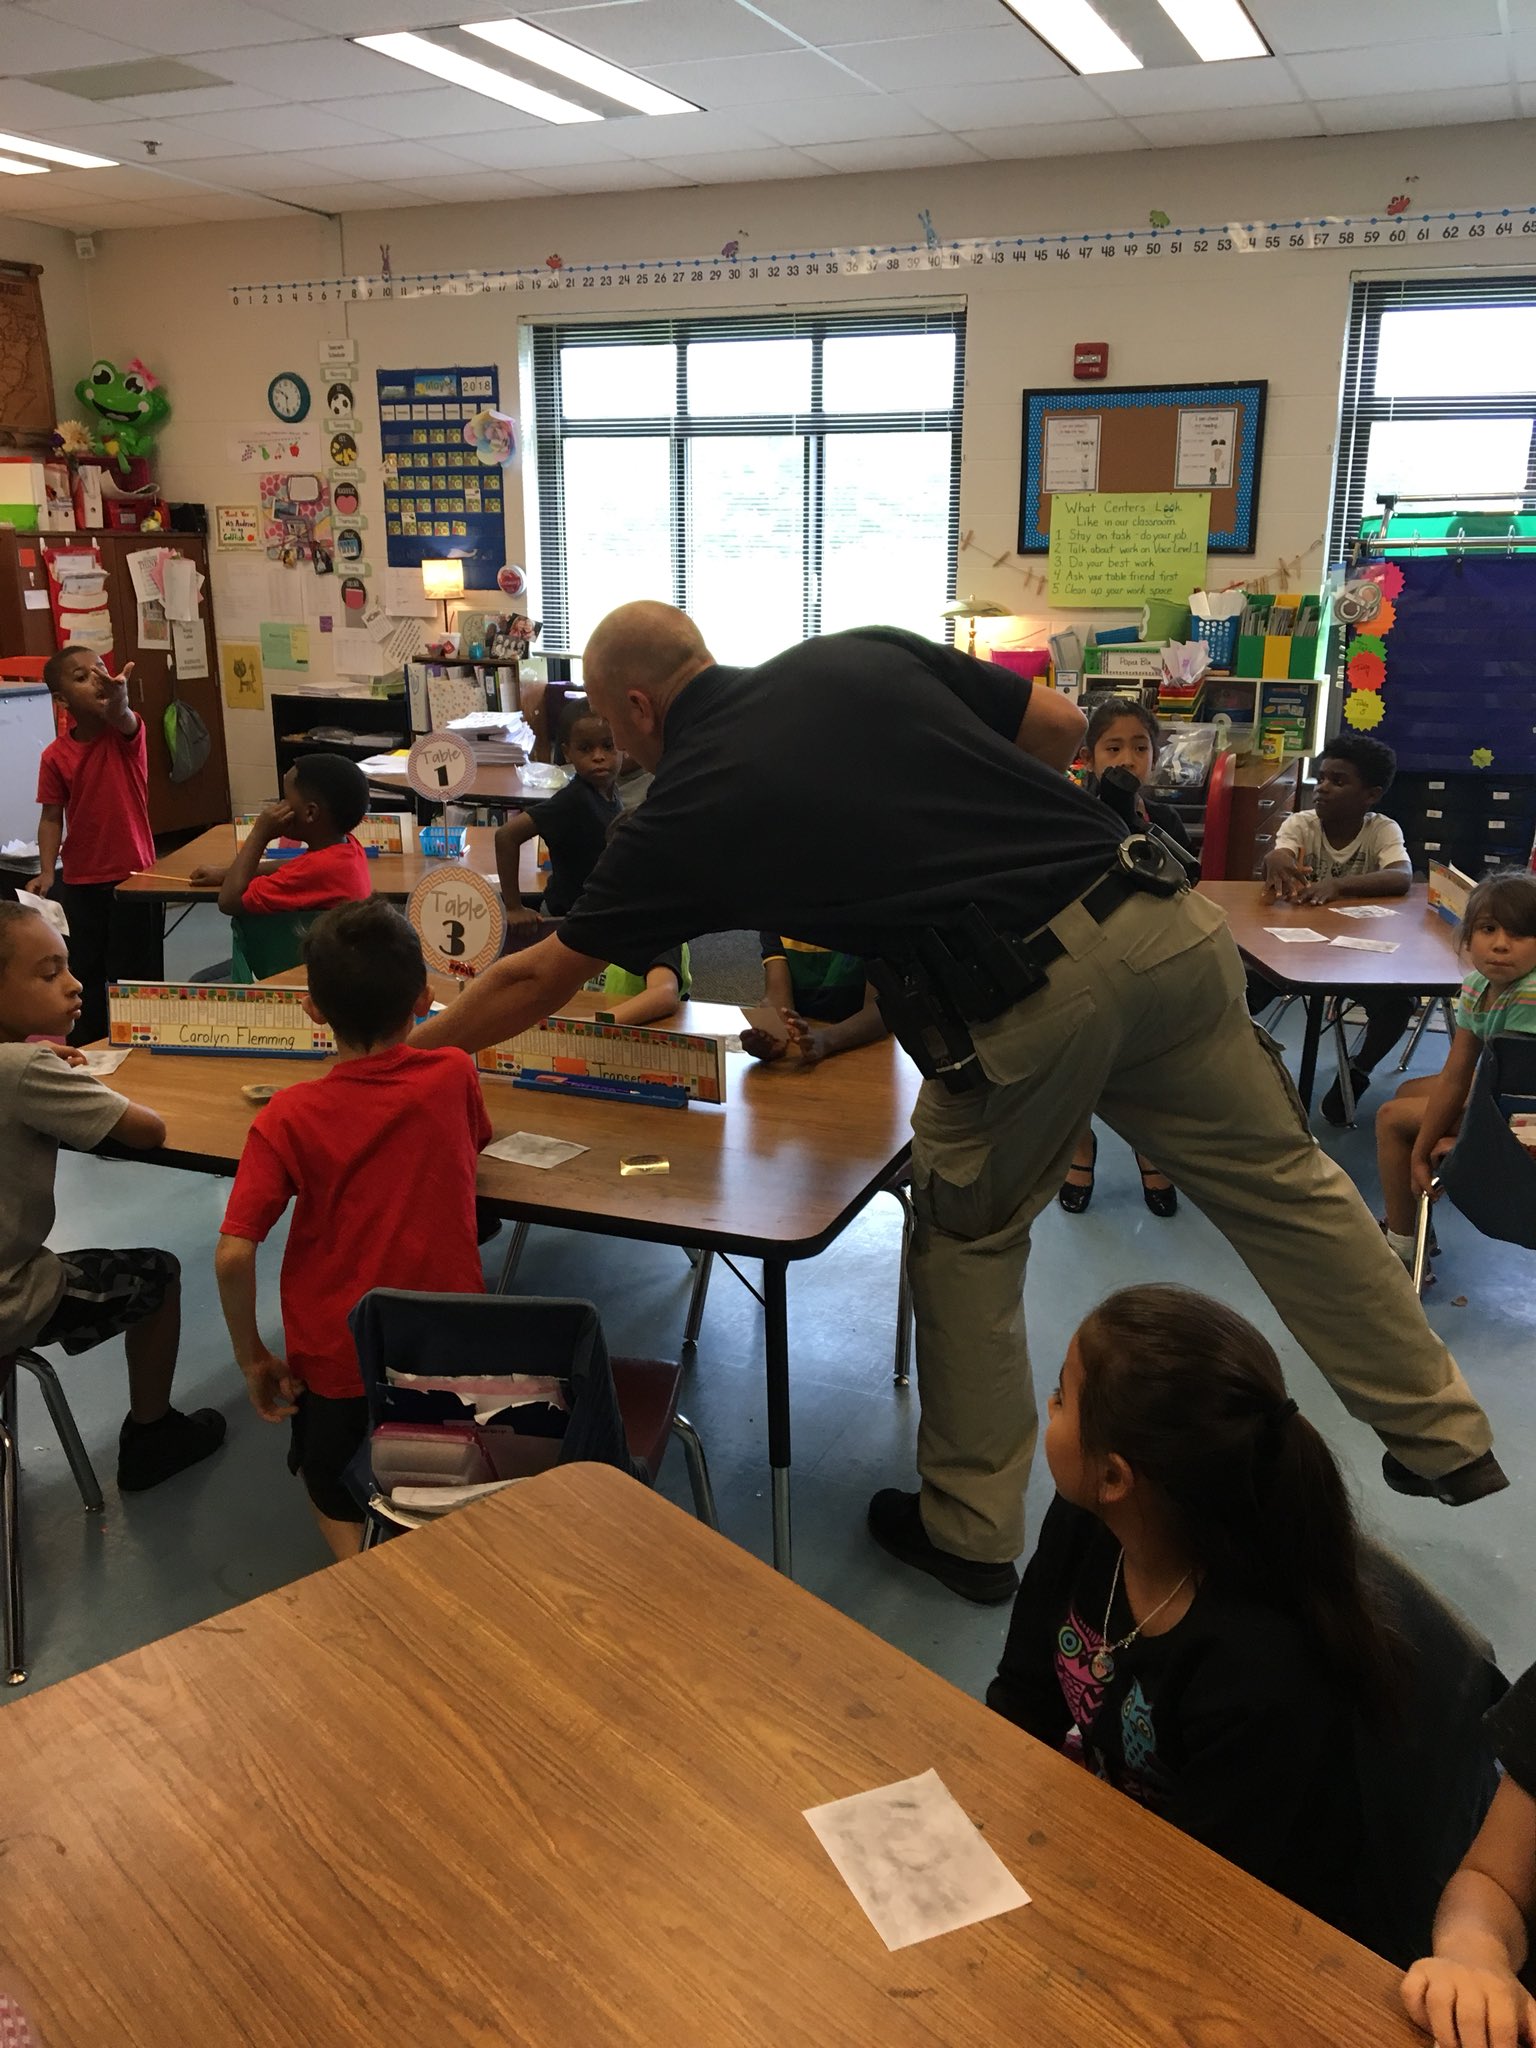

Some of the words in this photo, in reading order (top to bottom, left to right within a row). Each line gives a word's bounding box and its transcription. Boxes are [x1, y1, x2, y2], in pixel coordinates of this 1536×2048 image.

[233, 296, 239, 306] 0
[249, 296, 252, 304] 1
[262, 294, 268, 304] 2
[277, 293, 283, 304] 3
[292, 293, 298, 302] 4
[308, 292, 313, 302] 5
[321, 291, 327, 301] 6
[336, 289, 341, 299] 7
[352, 288, 357, 299] 8
[367, 288, 373, 298] 9
[382, 286, 391, 297] 10
[400, 286, 407, 296] 11
[432, 284, 441, 295] 13
[465, 282, 474, 293] 15
[481, 282, 491, 293] 16
[515, 280, 525, 290] 18
[532, 279, 541, 290] 19
[548, 280, 559, 289] 20
[566, 278, 575, 288] 21
[583, 277, 594, 287] 22
[600, 276, 612, 286] 23
[618, 275, 630, 285] 24
[636, 274, 648, 284] 25
[654, 273, 667, 284] 26
[672, 272, 685, 283] 27
[691, 270, 703, 282] 28
[710, 270, 722, 281] 29
[728, 269, 740, 280] 30
[749, 268, 758, 279] 31
[768, 266, 780, 278] 32
[787, 265, 799, 276] 33
[806, 264, 819, 275] 34
[826, 262, 838, 274] 35
[846, 261, 858, 272] 36
[886, 258, 900, 270] 38
[907, 257, 920, 269] 39
[928, 256, 940, 267] 40
[991, 252, 1004, 264] 43
[1013, 250, 1026, 262] 44
[1034, 250, 1048, 261] 45
[1056, 248, 1070, 260] 46
[1079, 247, 1093, 258] 47
[1101, 246, 1115, 257] 48
[1124, 244, 1138, 256] 49
[1146, 243, 1161, 255] 50
[1170, 242, 1182, 254] 51
[1194, 240, 1208, 253] 52
[1217, 239, 1232, 251] 53
[1265, 236, 1280, 248] 55
[1289, 234, 1304, 247] 56
[1314, 233, 1330, 245] 57
[1338, 232, 1354, 244] 58
[1364, 231, 1380, 243] 59
[1389, 229, 1406, 242] 60
[1417, 228, 1430, 240] 61
[1442, 226, 1459, 239] 62
[1468, 224, 1485, 237] 63
[1496, 222, 1512, 235] 64
[426, 381, 444, 392] May
[463, 381, 491, 391] 2018
[1065, 502, 1096, 514] What
[1104, 501, 1146, 513] Centers
[1155, 501, 1182, 512] Look
[1076, 516, 1099, 527] Like
[1069, 530, 1091, 542] Stay
[1112, 530, 1131, 540] task
[1140, 530, 1152, 540] do
[1153, 532, 1170, 544] your
[1068, 543, 1087, 554] Talk
[1090, 545, 1116, 553] about
[1120, 544, 1138, 553] work
[1069, 556, 1083, 568] Do
[1087, 560, 1104, 570] your
[1108, 557, 1130, 568] best
[1066, 571, 1084, 580] Ask
[1088, 574, 1103, 583] your
[1105, 572, 1127, 580] table
[1130, 570, 1155, 581] friend
[1159, 571, 1179, 582] first
[1064, 583, 1086, 594] Clean
[1091, 587, 1102, 595] up
[1106, 587, 1124, 597] your
[1126, 584, 1146, 595] work
[1150, 587, 1173, 598] space
[420, 748, 461, 765] Table
[434, 764, 449, 787] 1
[431, 890, 487, 922] Table
[438, 920, 465, 956] 3
[179, 1024, 230, 1046] Carolyn
[237, 1026, 295, 1050] Flemming
